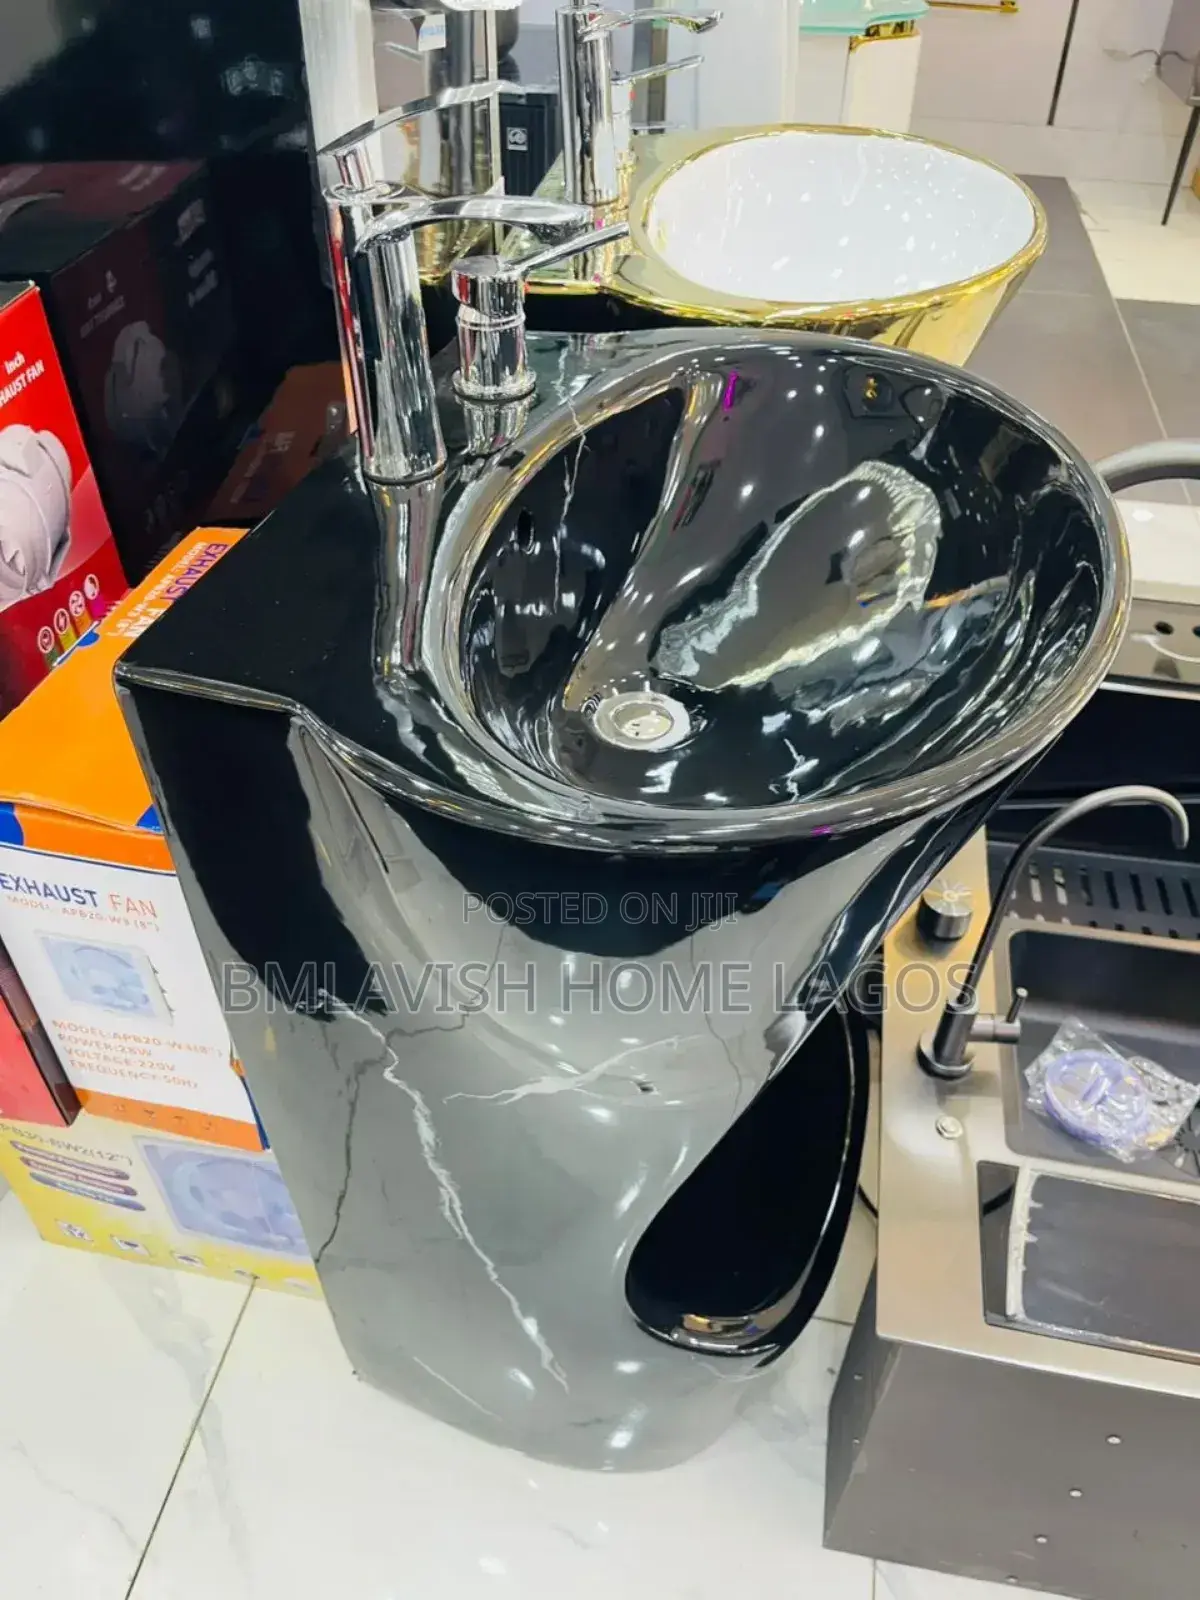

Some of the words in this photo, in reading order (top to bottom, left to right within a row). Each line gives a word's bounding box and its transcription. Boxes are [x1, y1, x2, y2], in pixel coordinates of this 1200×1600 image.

[25, 358, 45, 384] FAN
[0, 873, 98, 908] EXHAUST
[109, 893, 158, 919] FAN
